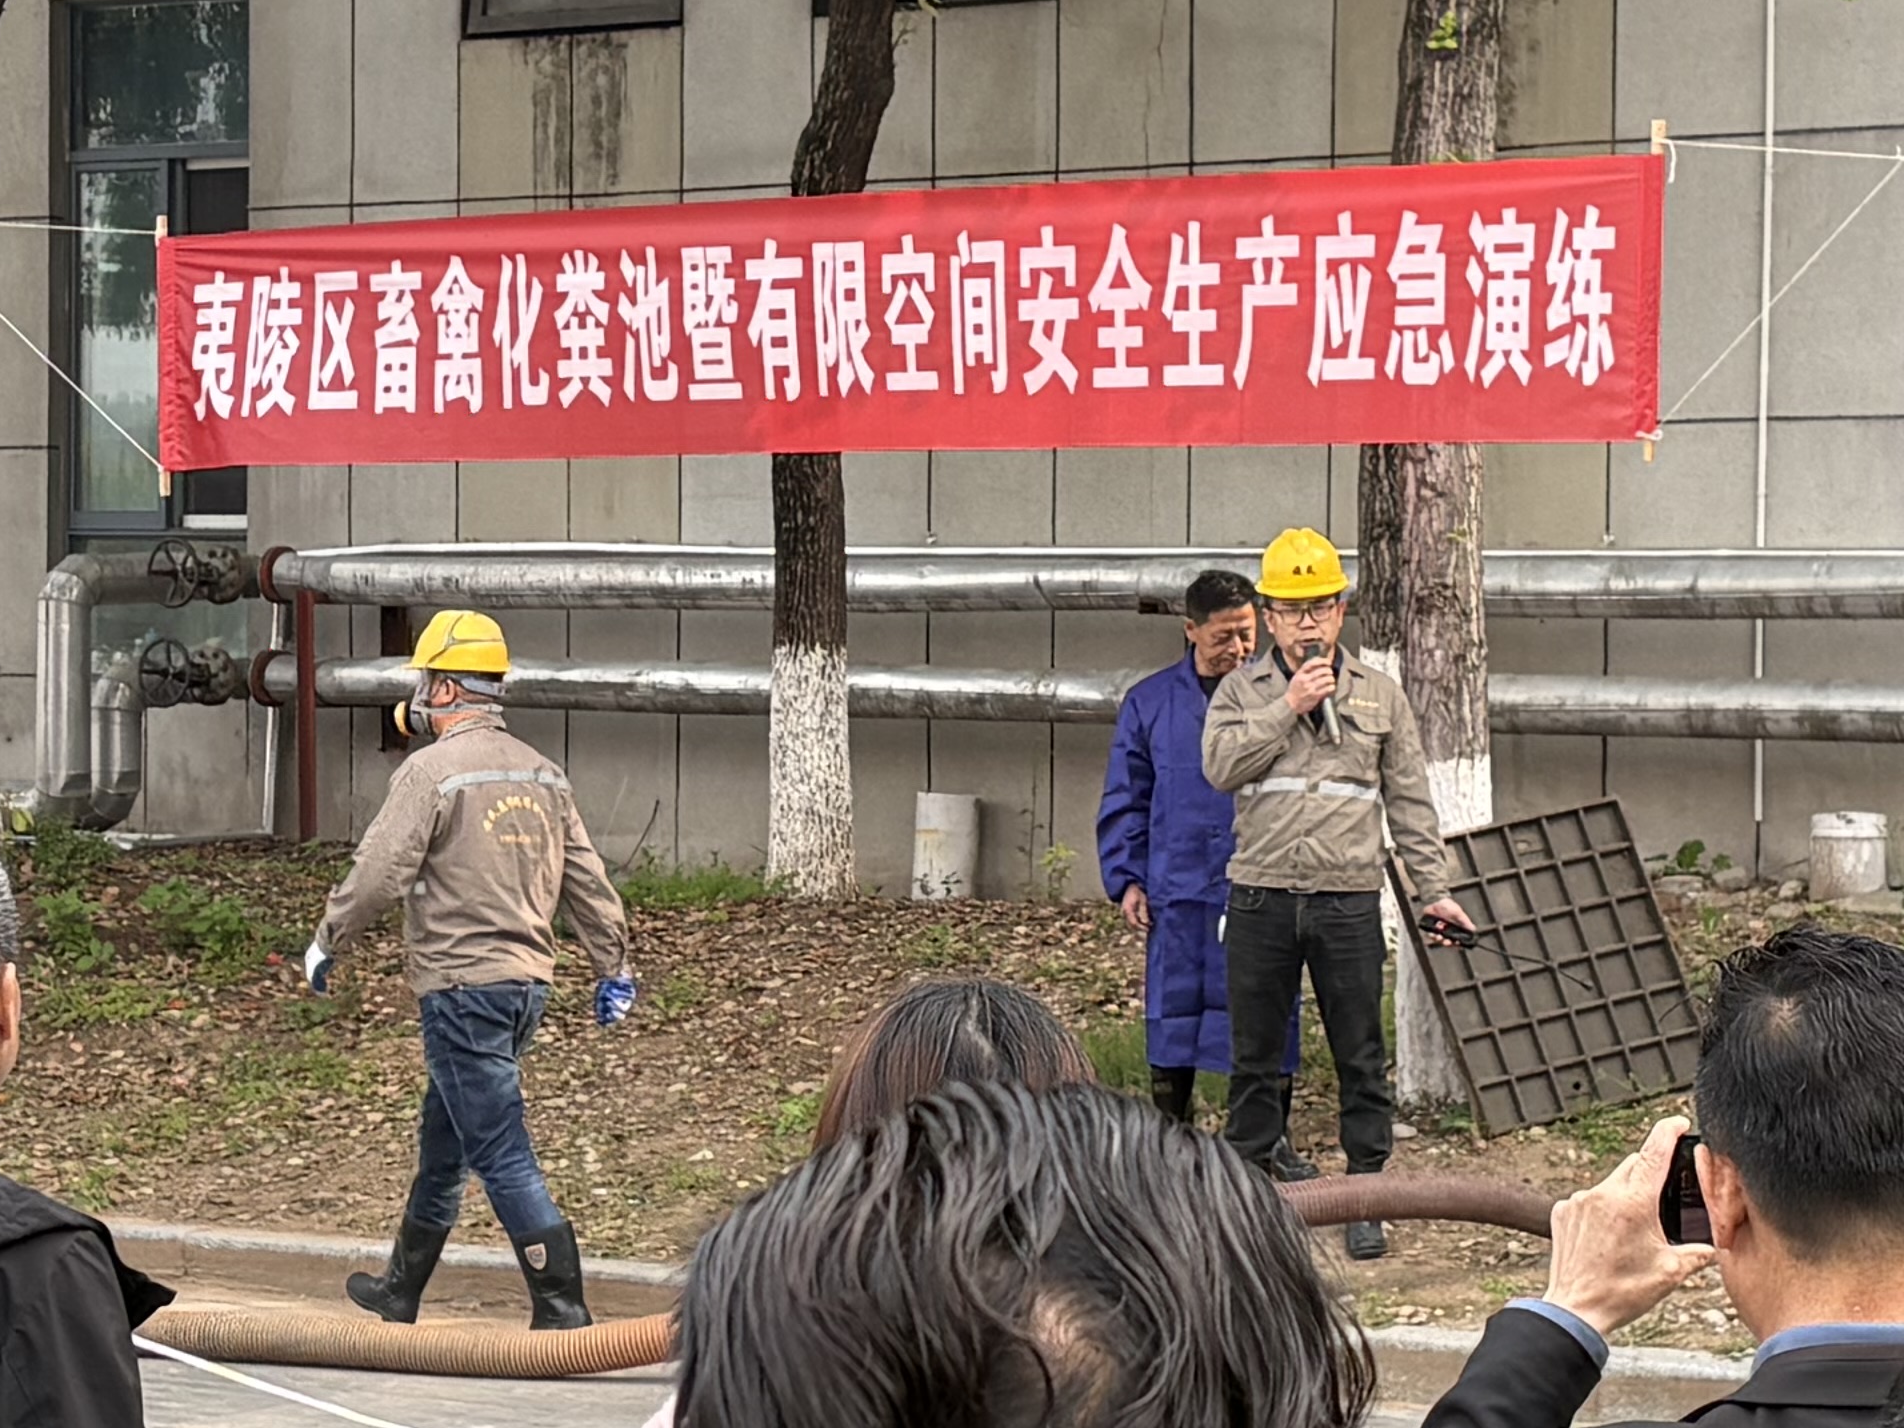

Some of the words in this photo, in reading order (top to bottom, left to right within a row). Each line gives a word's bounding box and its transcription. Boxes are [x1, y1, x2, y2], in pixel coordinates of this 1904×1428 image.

[193, 203, 1616, 422] 夷陵区畜禽化粪池暨有限空间安全生产应急演练
